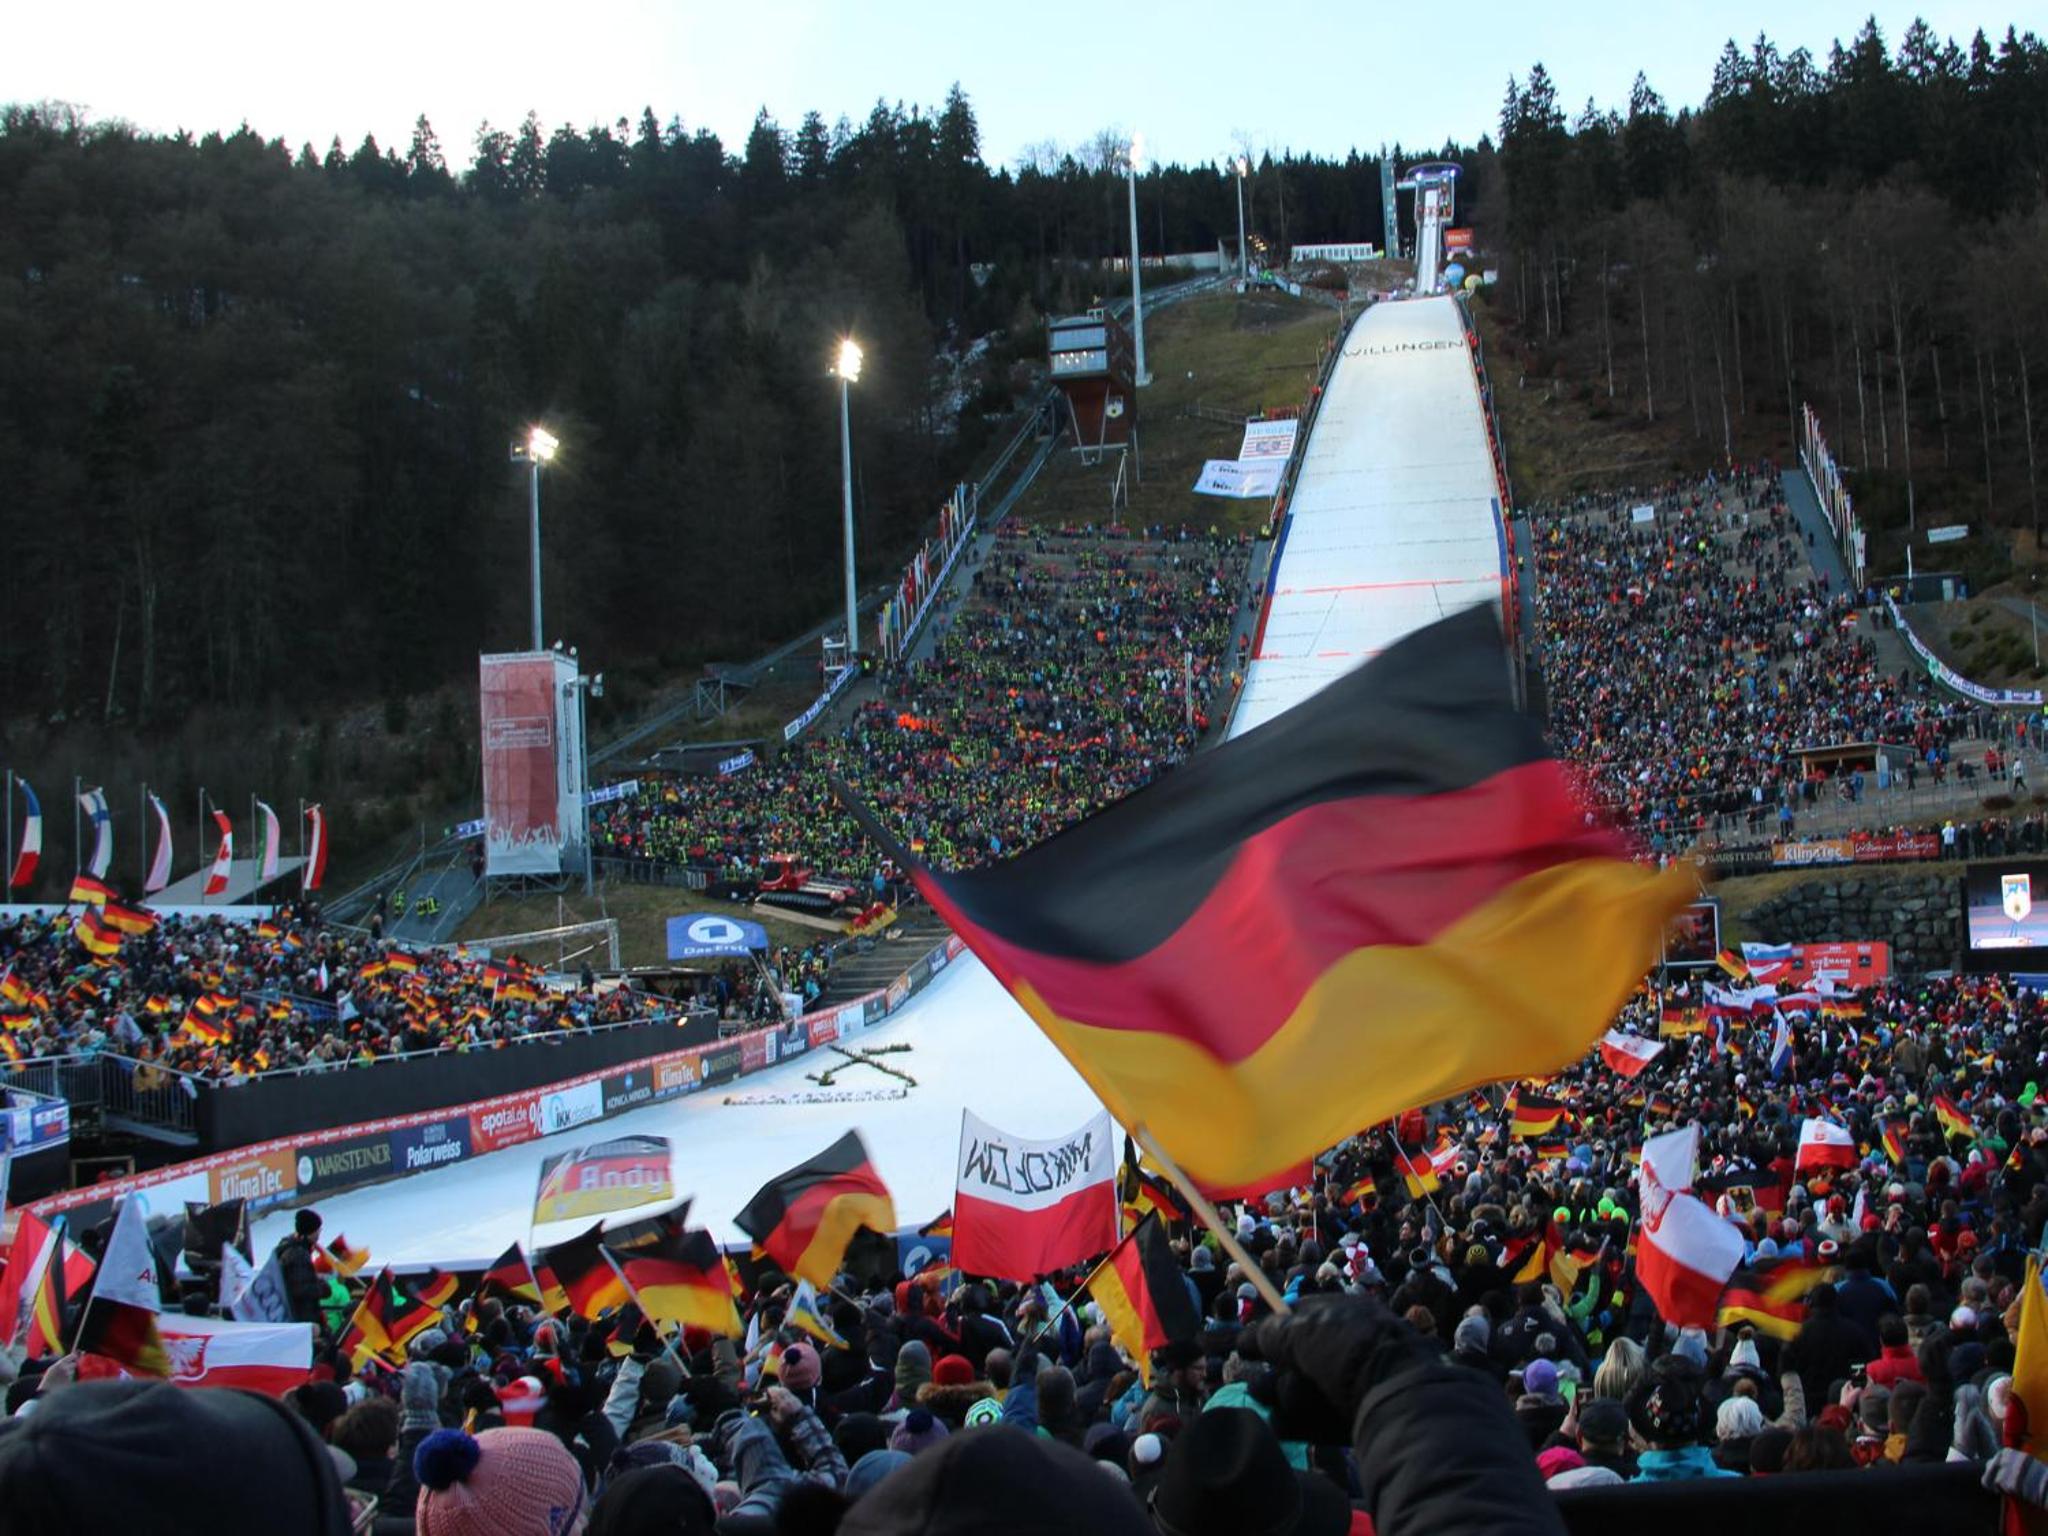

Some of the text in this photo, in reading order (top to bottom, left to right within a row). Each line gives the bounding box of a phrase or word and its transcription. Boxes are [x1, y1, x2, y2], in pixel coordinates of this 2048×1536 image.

[1343, 339, 1464, 357] WILLINGEN
[1783, 845, 1842, 863] KlimaTec
[481, 1105, 528, 1137] apotal.de
[314, 1144, 391, 1177] WARSTEINER
[407, 1139, 462, 1168] Polarweiss
[221, 1166, 283, 1203] KlimaTec
